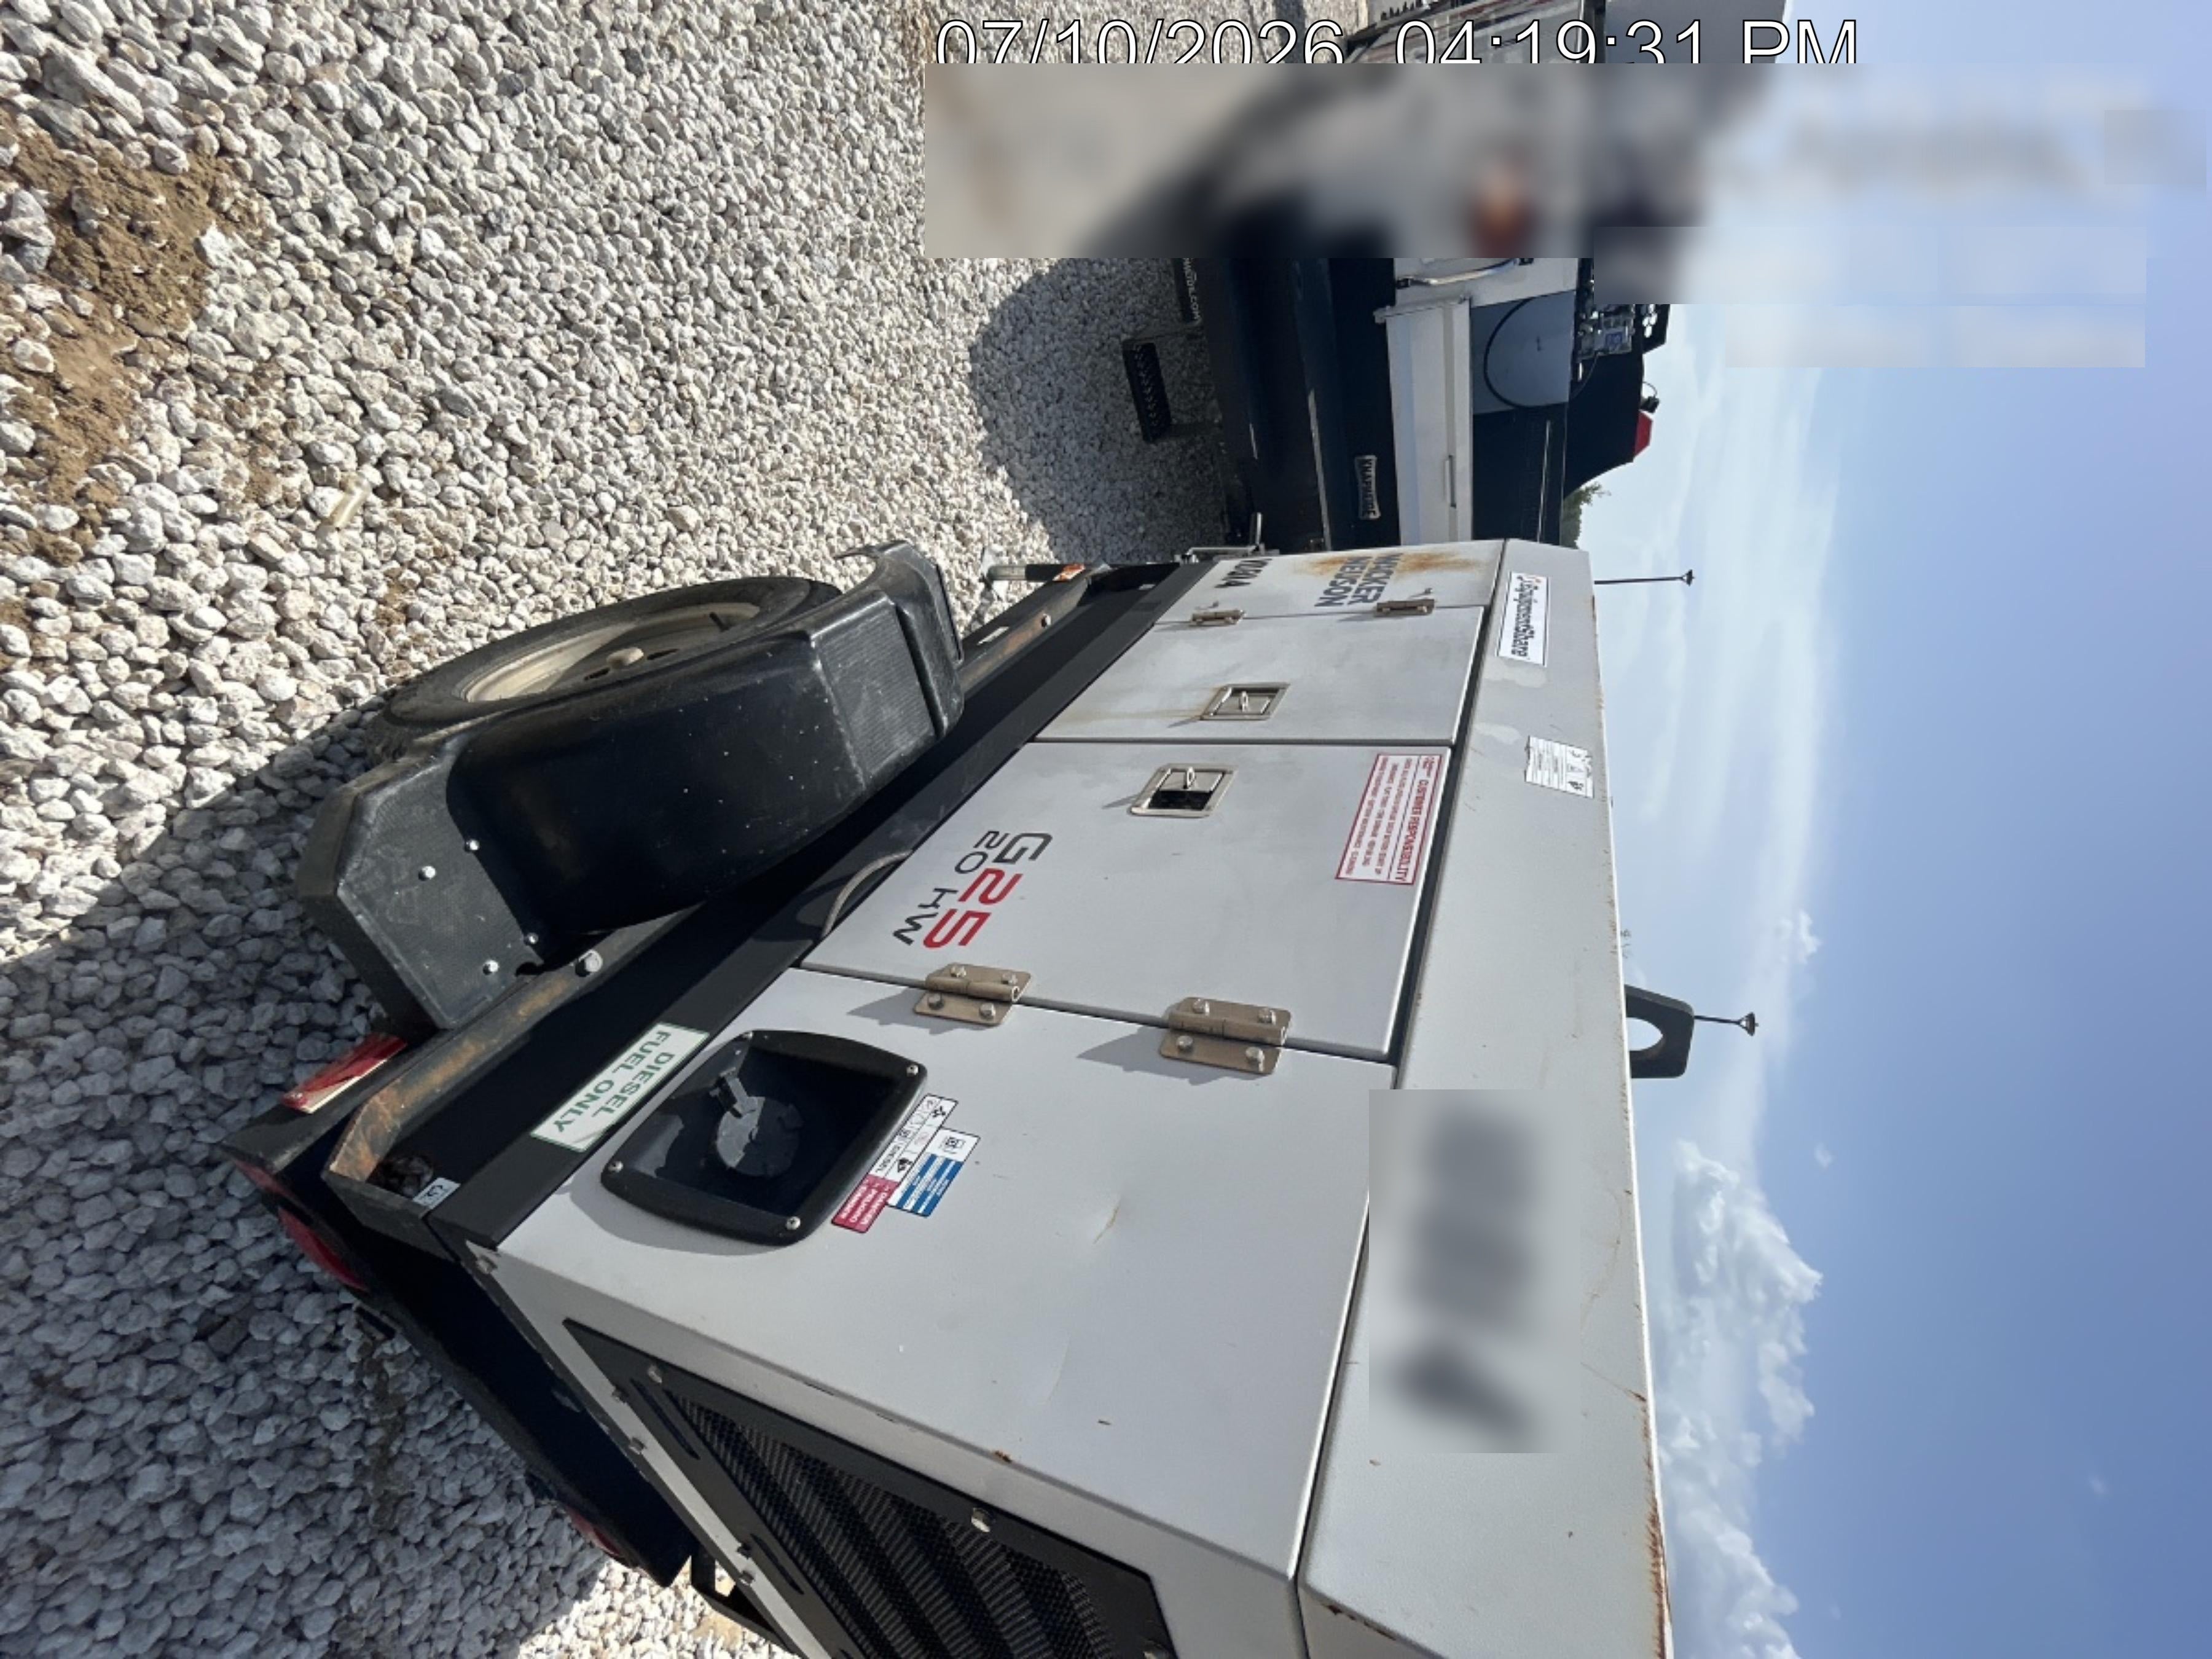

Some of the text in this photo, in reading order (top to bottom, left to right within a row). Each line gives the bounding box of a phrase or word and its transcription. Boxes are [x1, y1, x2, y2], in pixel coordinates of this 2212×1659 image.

[1314, 556, 1373, 607] NEUSON
[1347, 553, 1405, 605] WACKER
[1512, 583, 1539, 657] EquipmentShare
[1411, 779, 1429, 815] CUSTOMER
[954, 831, 1010, 874] 20
[1395, 816, 1419, 882] RESPONSIBILITY
[924, 833, 1053, 948] G25
[553, 1030, 672, 1132] FUEL ONLY
[592, 1051, 676, 1117] DIESEL
[875, 1144, 901, 1173] DIESEL
[849, 1188, 878, 1223] PELIGRO
[860, 1191, 890, 1225] DANGER
